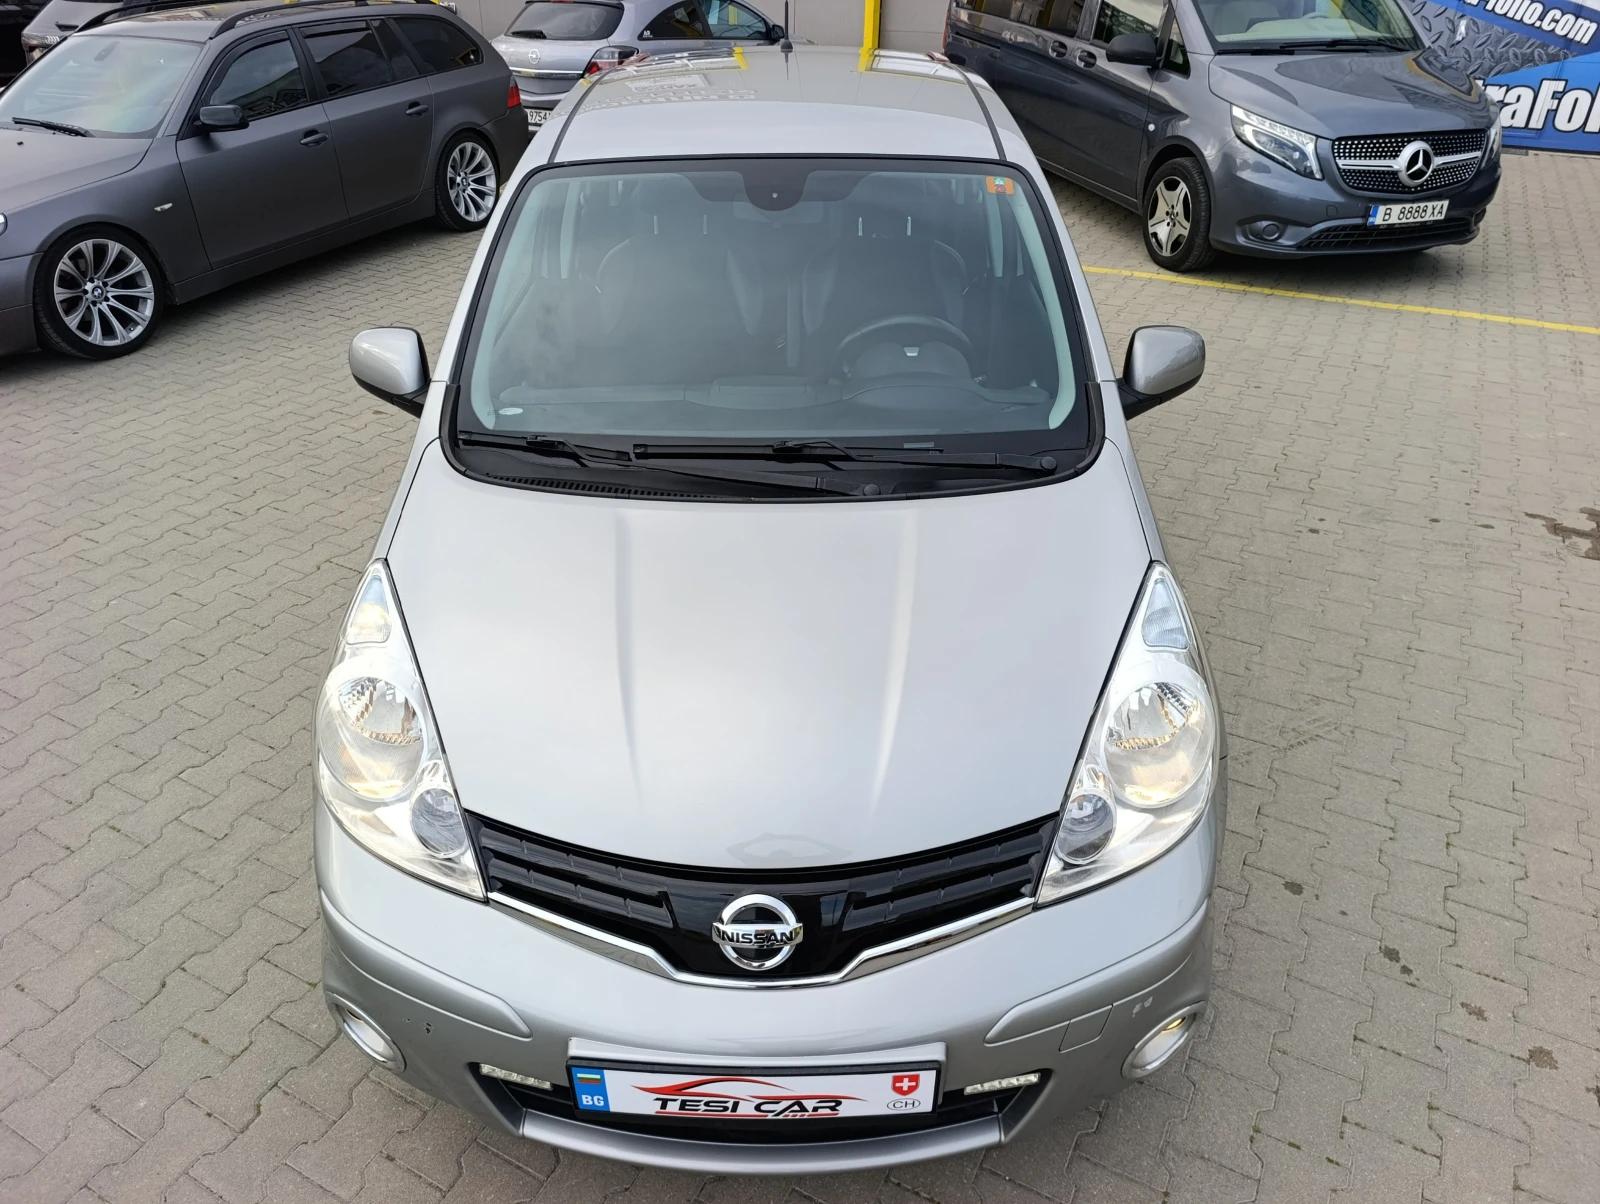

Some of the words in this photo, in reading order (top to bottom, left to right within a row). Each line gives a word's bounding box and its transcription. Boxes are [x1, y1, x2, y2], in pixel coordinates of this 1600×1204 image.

[529, 110, 547, 122] 9754
[1382, 207, 1392, 222] B
[1397, 204, 1428, 220] 8888
[1429, 203, 1444, 219] XA
[721, 931, 794, 944] NISSAN
[581, 1094, 605, 1107] BG
[653, 1097, 741, 1113] TESI
[753, 1099, 843, 1117] CAR
[892, 1101, 916, 1109] CH
